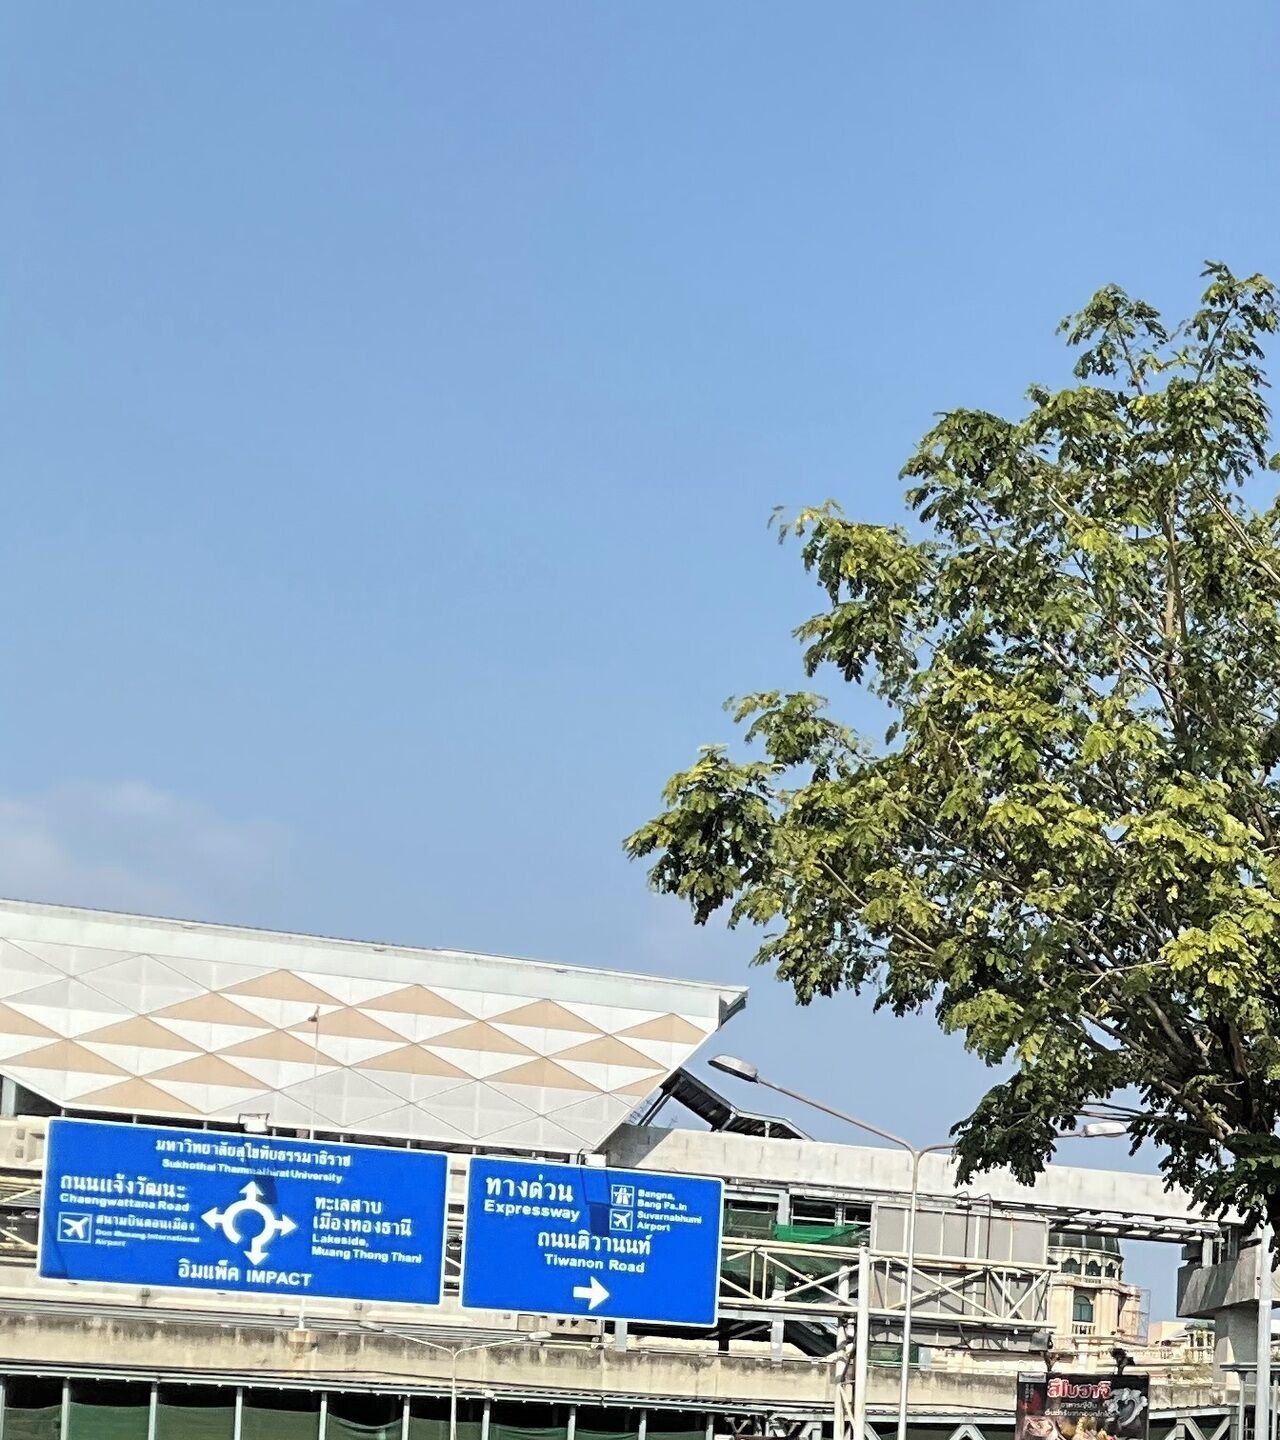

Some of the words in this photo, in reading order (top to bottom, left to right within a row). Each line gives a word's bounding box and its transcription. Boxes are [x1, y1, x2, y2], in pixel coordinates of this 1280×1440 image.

[161, 1158, 215, 1173] Sukhothai
[289, 1169, 343, 1184] University
[60, 1172, 188, 1199] ถนนแจ้งวัฒนะ
[485, 1174, 574, 1203] ทางด่วน
[59, 1193, 155, 1210] Chaengwattana
[157, 1201, 190, 1213] Road
[315, 1196, 382, 1215] ทะเลสาบ
[484, 1199, 580, 1223] Expressway
[637, 1199, 662, 1211] Bang
[96, 1214, 196, 1232] สนามบินดอนเมือง
[313, 1213, 412, 1237] เมืองทองธานี
[636, 1220, 670, 1232] Airport
[637, 1210, 703, 1225] Suvarnabhumi
[95, 1239, 126, 1248] Airport
[537, 1229, 653, 1255] ถนนติวานนท์
[312, 1246, 351, 1260] Muang
[353, 1249, 389, 1263] Thong
[391, 1251, 422, 1264] Thani
[544, 1253, 604, 1270] Tiwanon
[609, 1259, 645, 1274] Road
[178, 1258, 239, 1282] อิมแพ็ค
[246, 1269, 312, 1287] IMPACT
